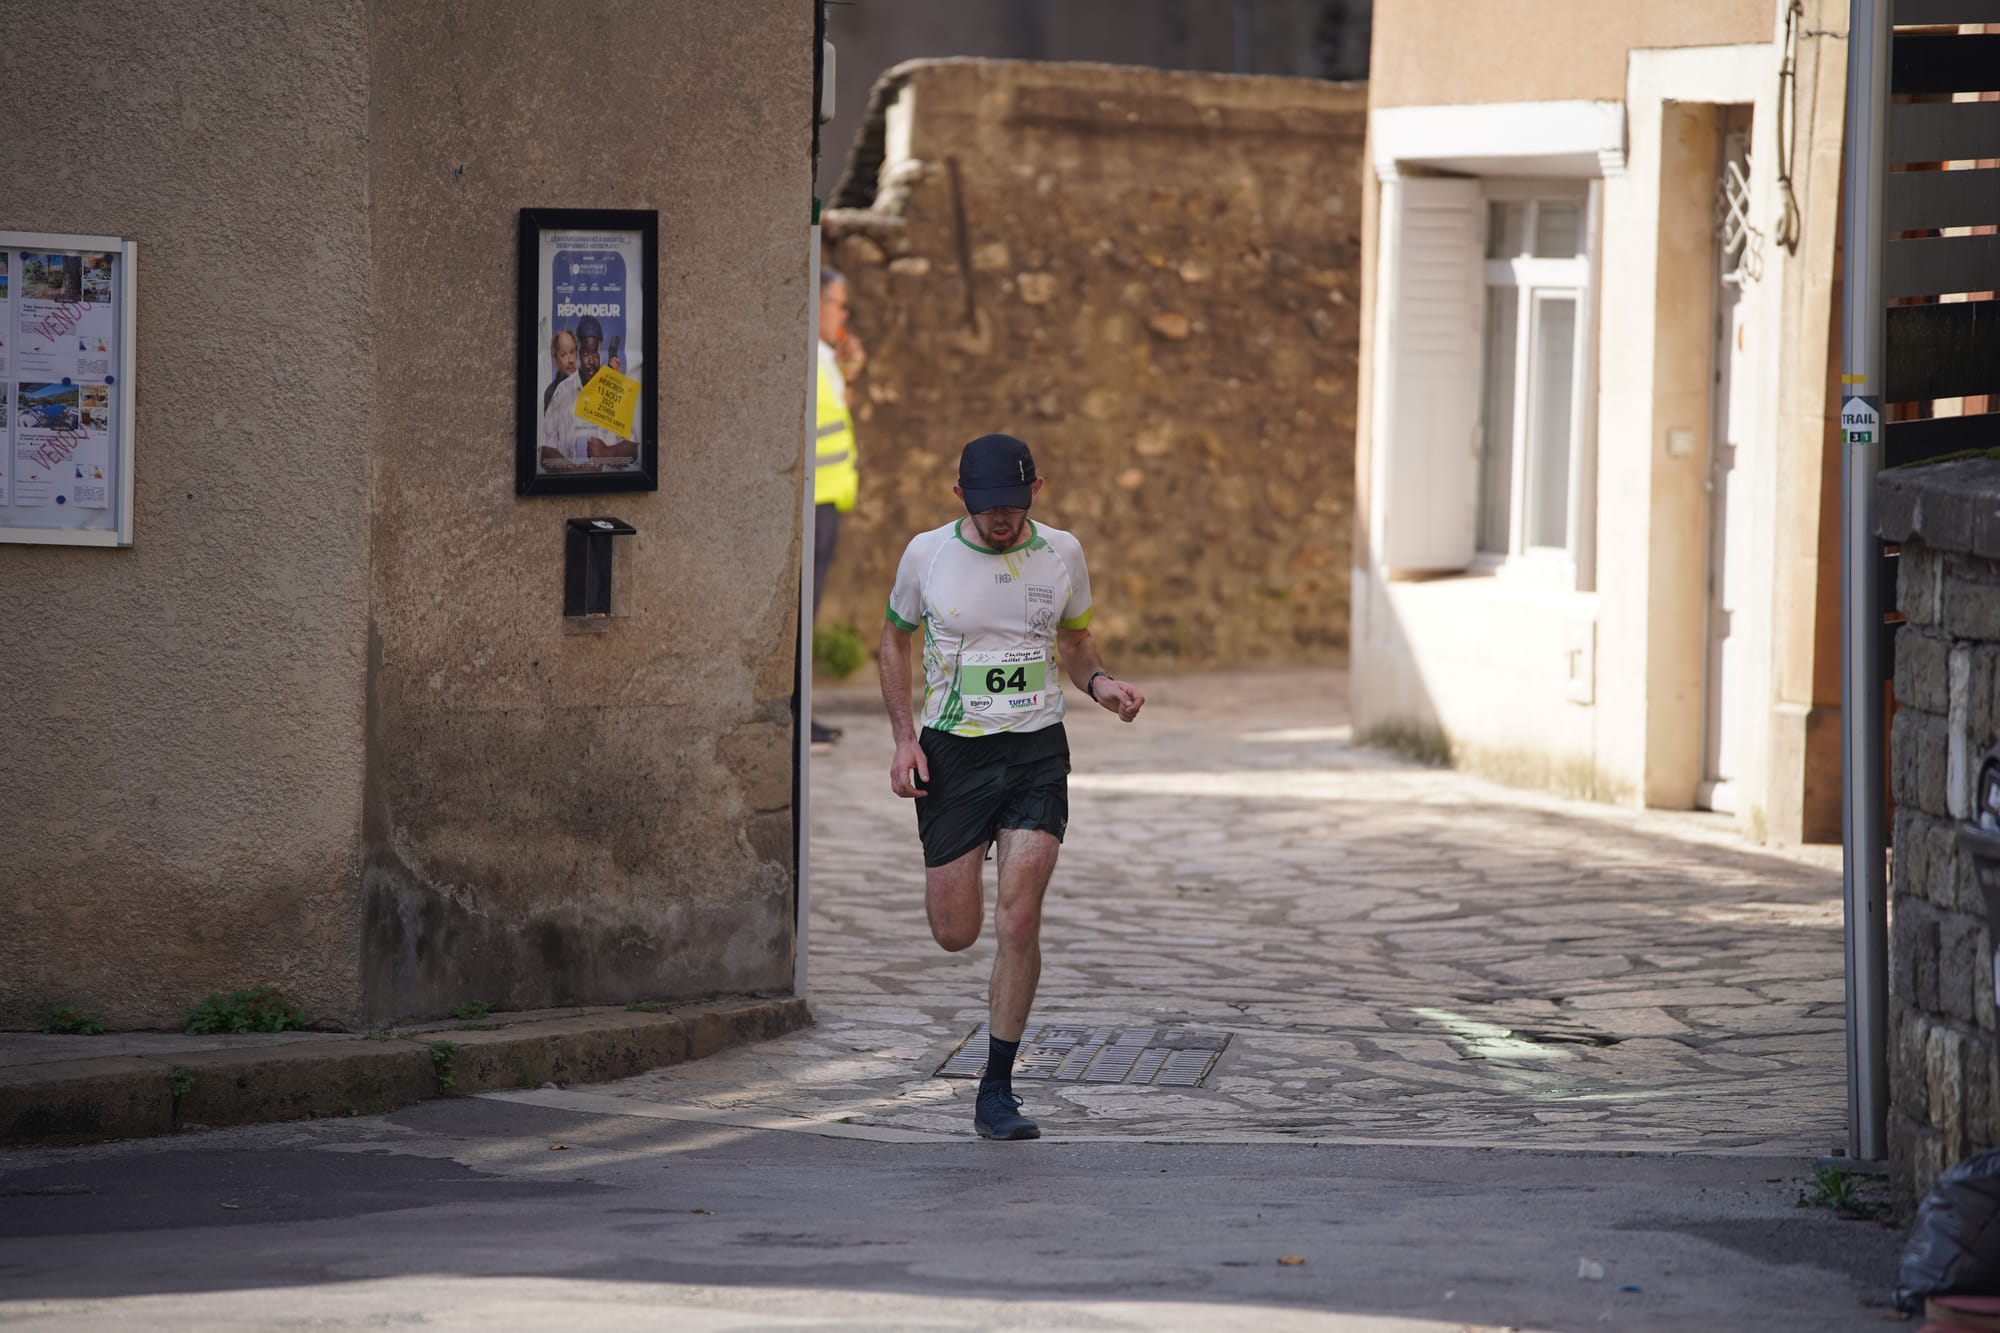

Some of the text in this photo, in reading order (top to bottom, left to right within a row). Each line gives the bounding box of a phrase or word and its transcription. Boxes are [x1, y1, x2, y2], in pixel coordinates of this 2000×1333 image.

[33, 298, 91, 343] VENDU
[598, 386, 605, 396] 13
[1842, 413, 1876, 425] TRAIL
[31, 424, 90, 471] VENDU
[986, 666, 1027, 693] 64
